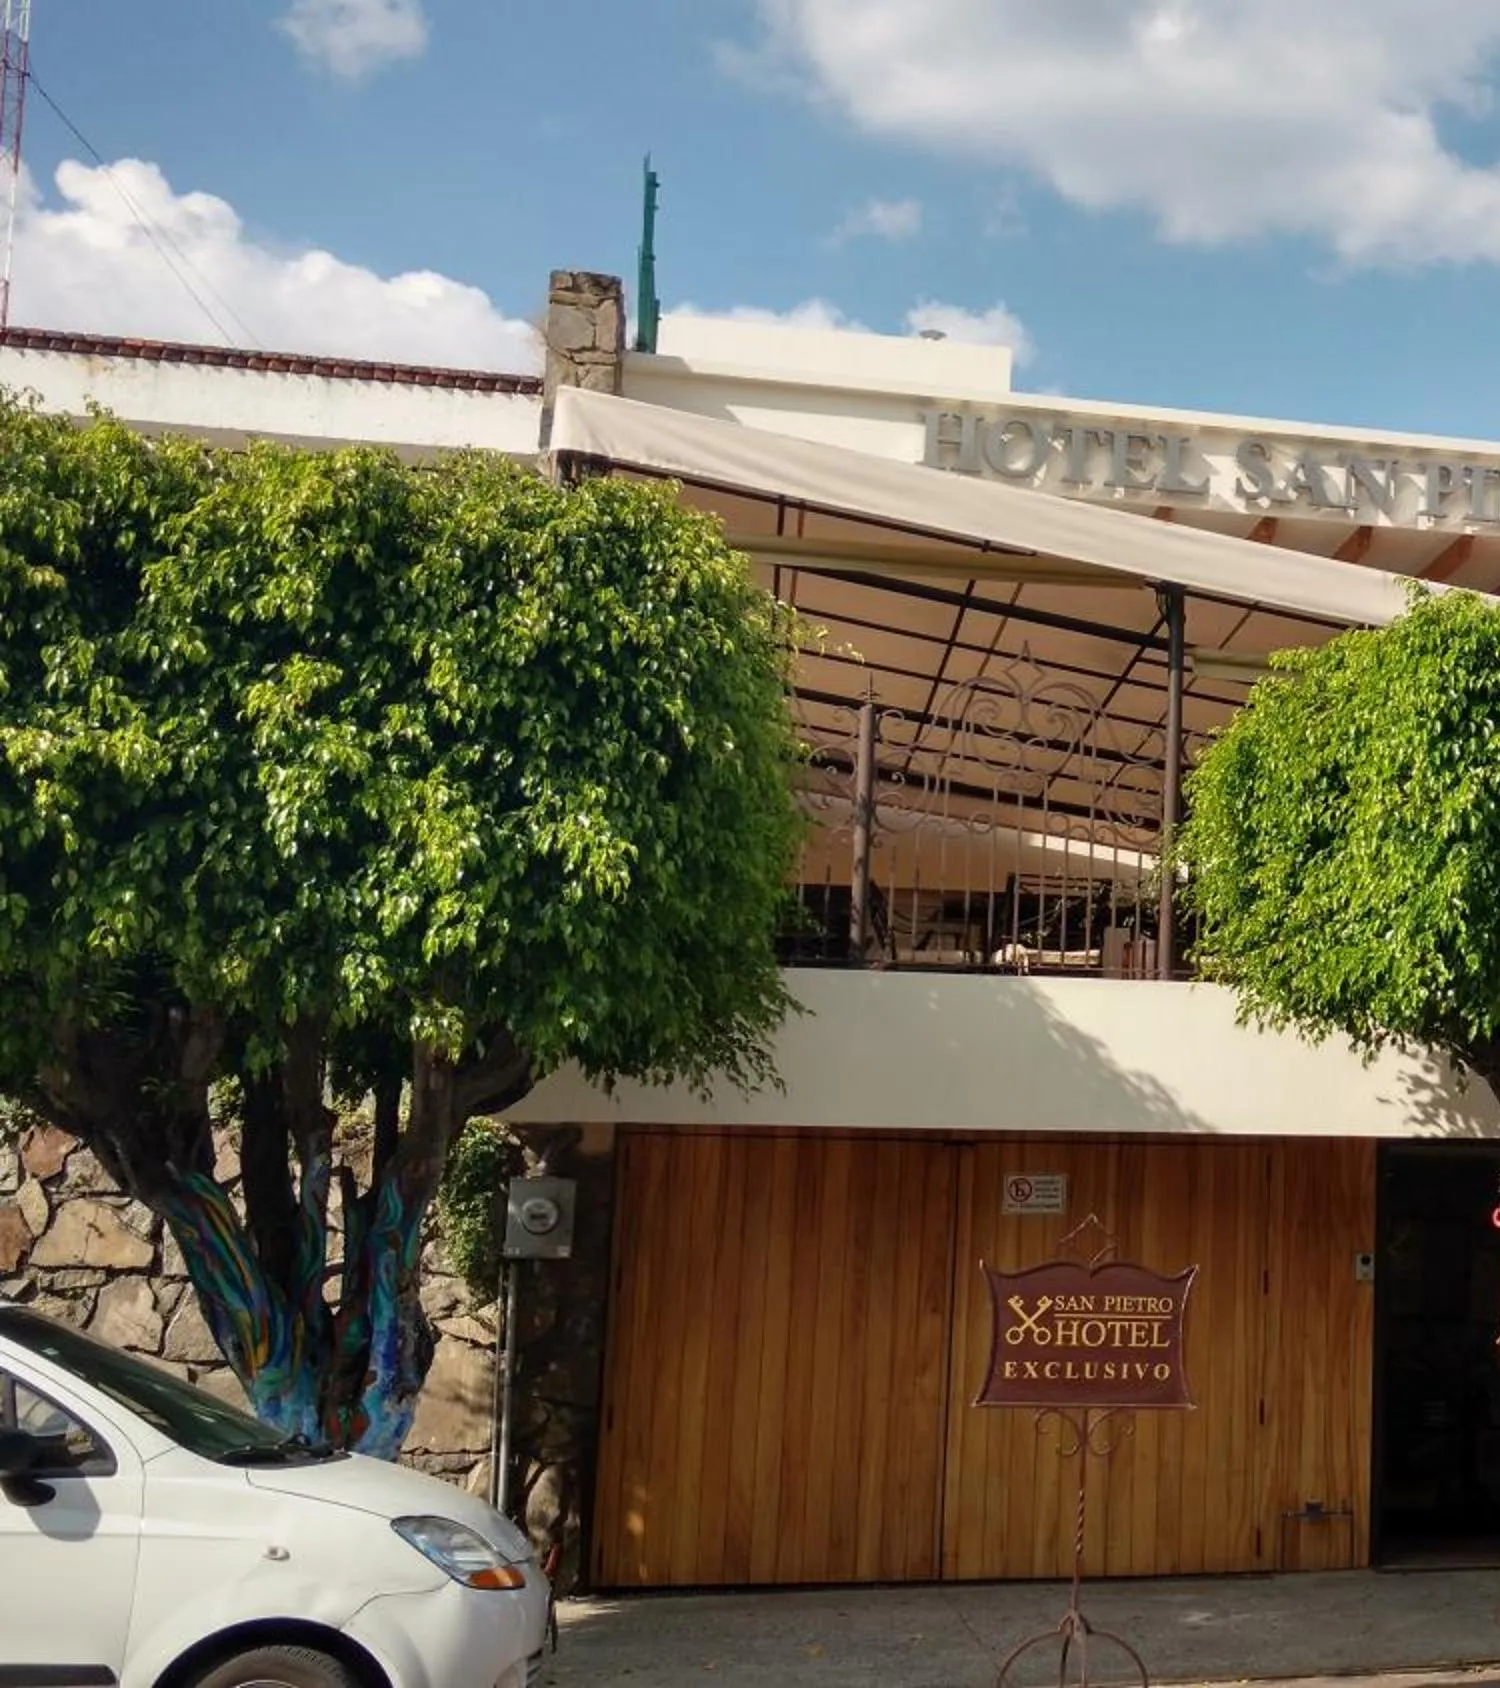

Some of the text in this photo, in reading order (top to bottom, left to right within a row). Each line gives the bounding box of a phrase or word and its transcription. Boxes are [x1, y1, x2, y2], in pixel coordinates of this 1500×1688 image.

[917, 411, 1210, 495] HOTEL
[1234, 436, 1400, 516] SAN
[1054, 1295, 1173, 1313] SAN PIETRO
[1055, 1320, 1171, 1347] HOTEL
[1004, 1361, 1170, 1380] EXCLUSIVO
